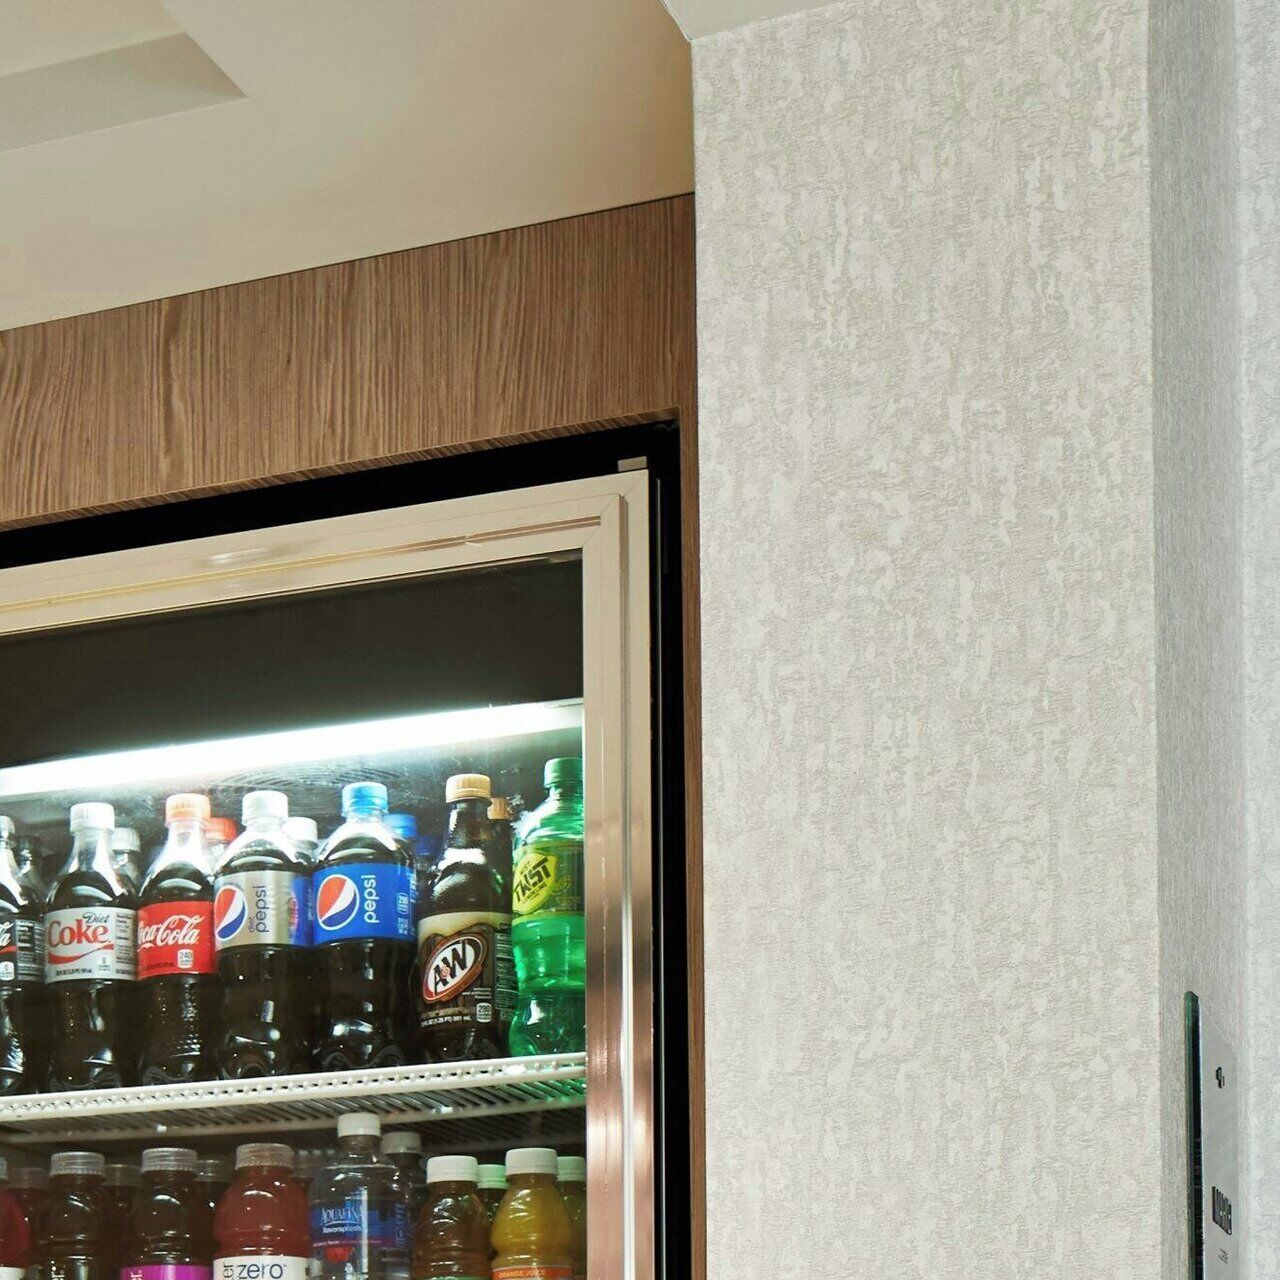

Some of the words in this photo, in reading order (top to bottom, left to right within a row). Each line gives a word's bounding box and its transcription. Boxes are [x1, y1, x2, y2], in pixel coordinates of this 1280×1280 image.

[253, 885, 270, 934] pepsi
[361, 874, 380, 924] pepsi
[47, 918, 108, 948] Coke
[82, 911, 111, 924] Diet
[138, 914, 206, 952] ca-Cola
[237, 1263, 284, 1280] zero
